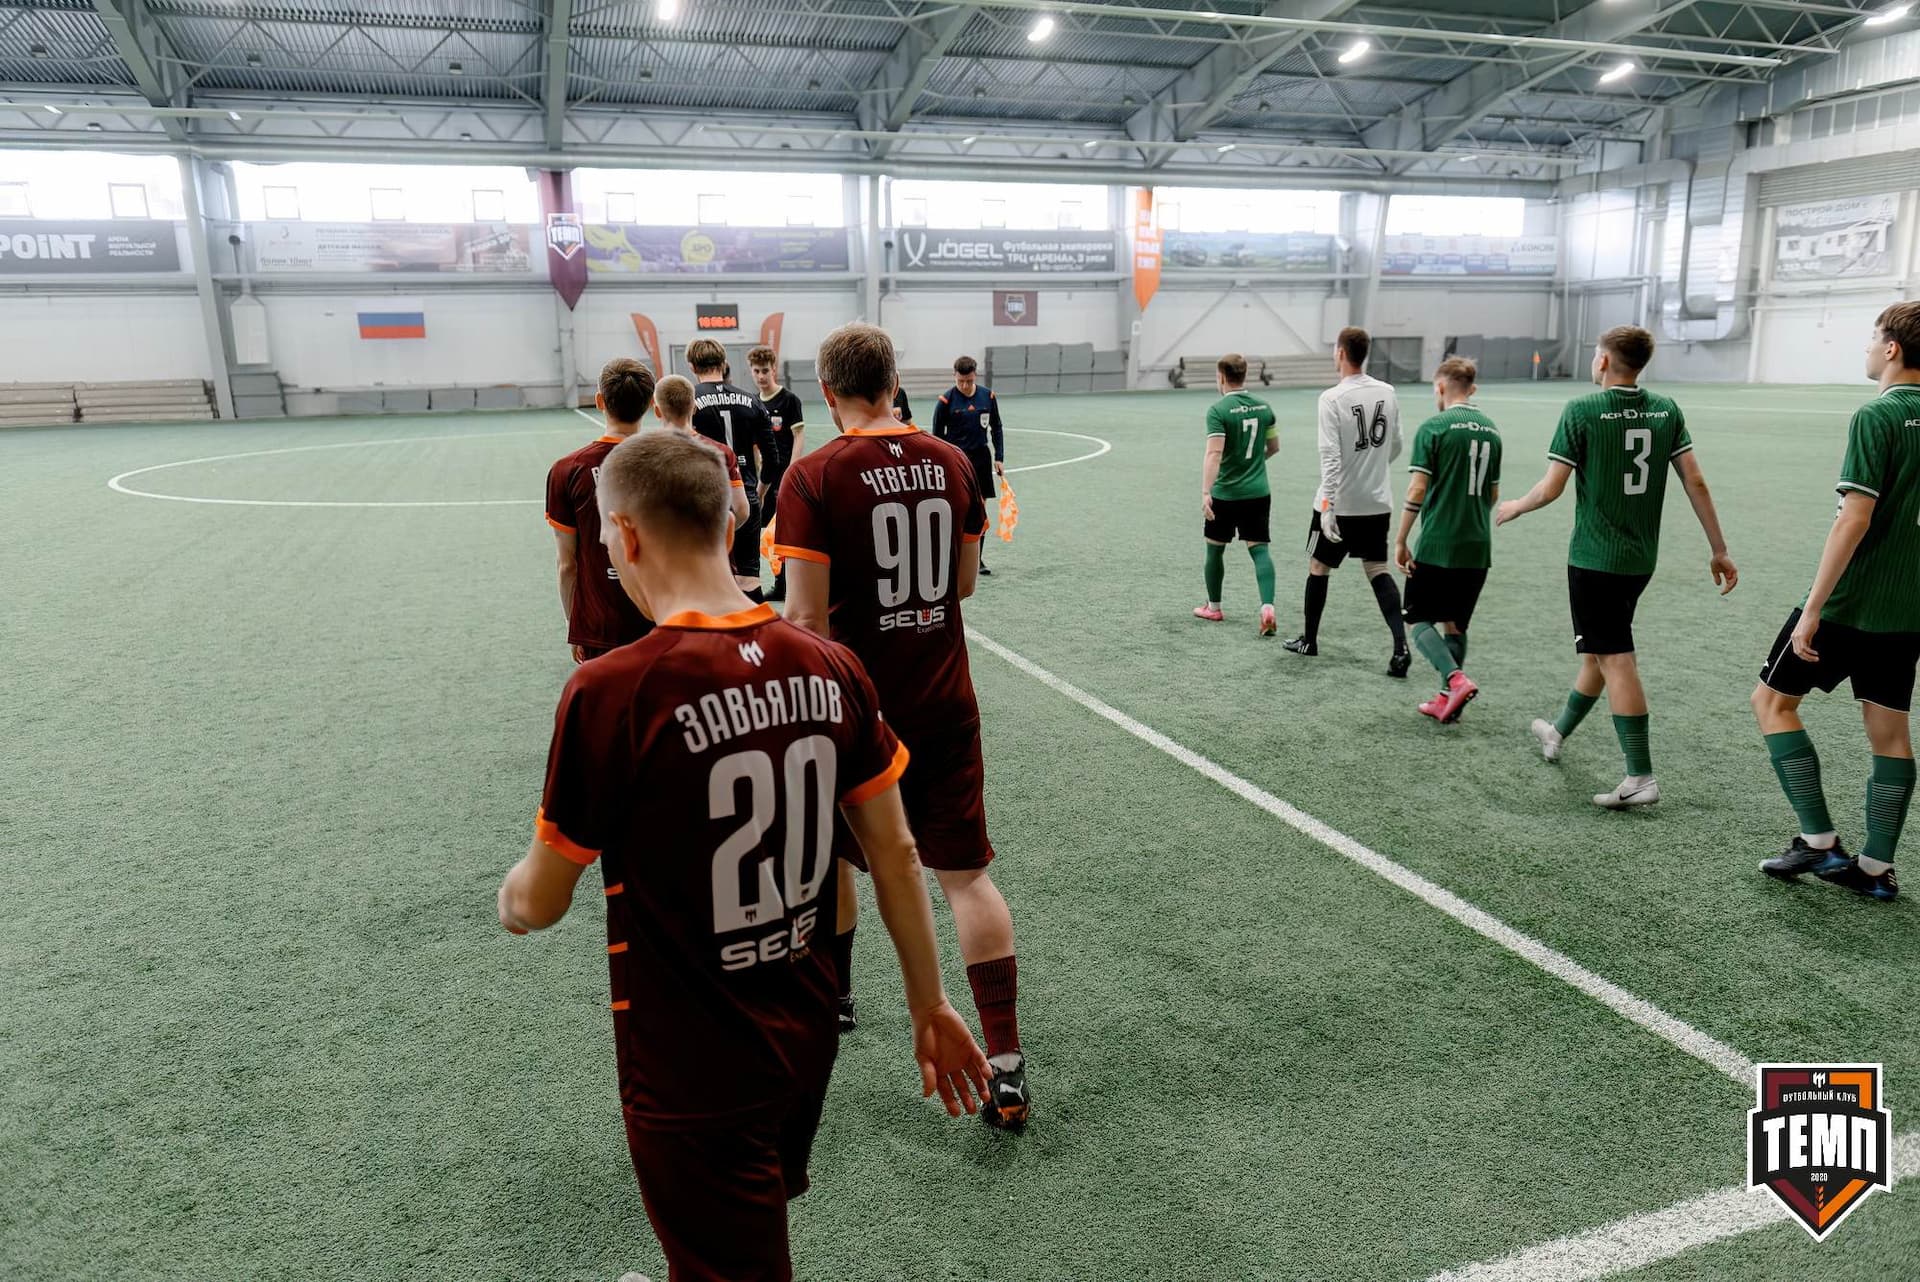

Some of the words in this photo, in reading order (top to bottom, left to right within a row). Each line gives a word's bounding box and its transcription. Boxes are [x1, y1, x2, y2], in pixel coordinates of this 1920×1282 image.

[719, 410, 735, 450] 1
[1242, 418, 1259, 459] 7
[1352, 401, 1387, 451] 16
[860, 458, 946, 497] ЧЕВЕЛЁВ
[1468, 439, 1491, 497] 11
[1623, 428, 1651, 495] 3
[871, 498, 953, 608] 90
[879, 605, 945, 632] SEUS
[674, 675, 844, 754] ЗАВЬЯЛОВ
[708, 734, 837, 934] 20
